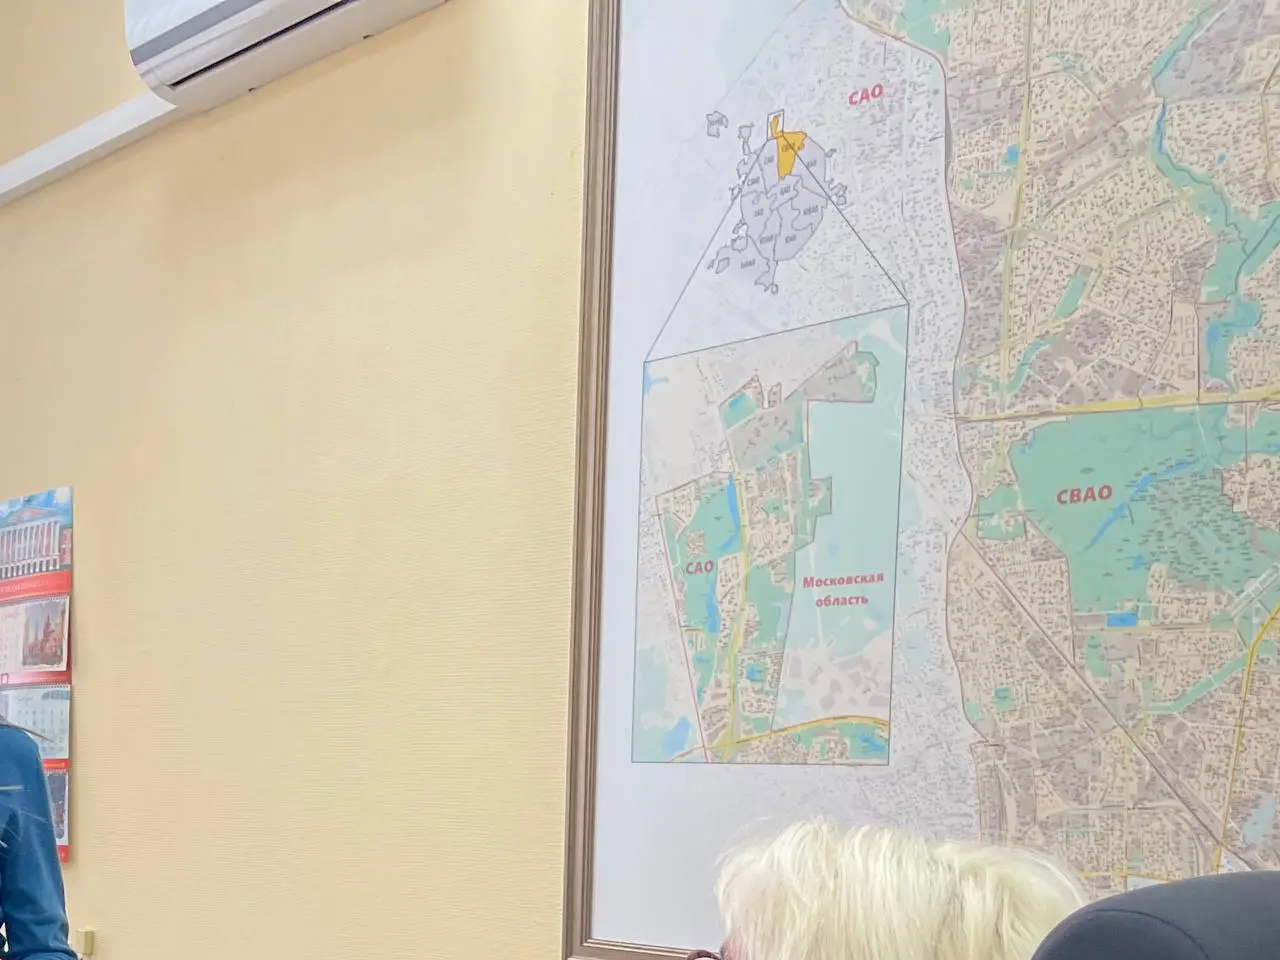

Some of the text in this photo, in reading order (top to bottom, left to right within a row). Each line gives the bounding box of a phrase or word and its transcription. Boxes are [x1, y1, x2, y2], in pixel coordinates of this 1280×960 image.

[848, 83, 884, 106] САО
[1056, 484, 1113, 505] СВАО
[685, 560, 714, 574] САО
[803, 573, 884, 588] Московская
[816, 594, 869, 607] область
